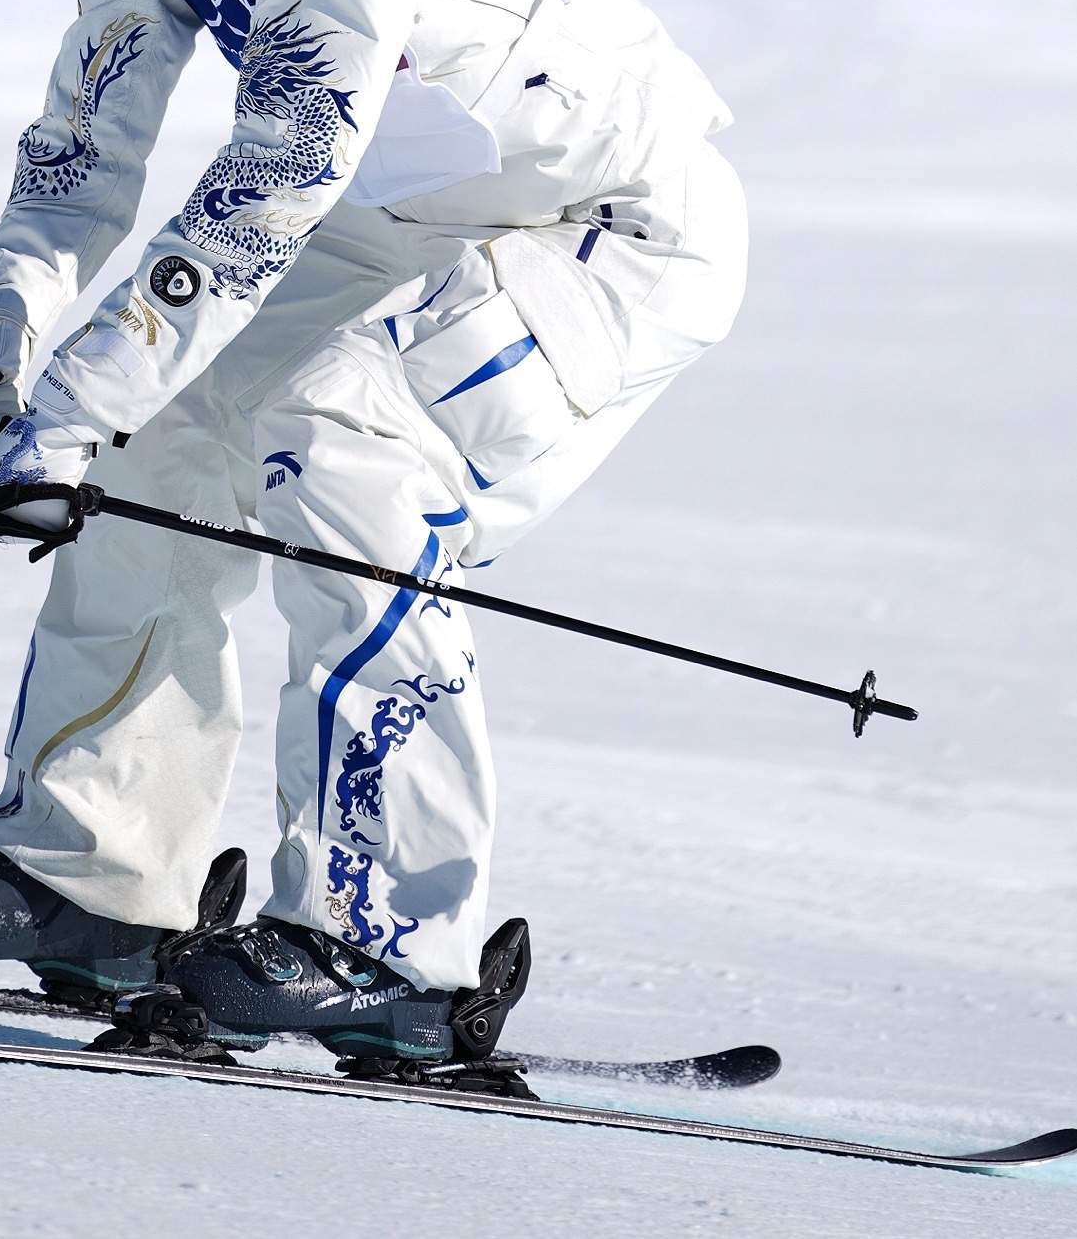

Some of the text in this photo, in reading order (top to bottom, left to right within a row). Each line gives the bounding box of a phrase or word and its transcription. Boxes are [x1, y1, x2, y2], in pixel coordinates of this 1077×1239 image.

[114, 307, 144, 333] ANTA
[46, 373, 75, 402] EILEEN
[265, 467, 286, 492] ANTA
[350, 983, 409, 1012] ATOMIC
